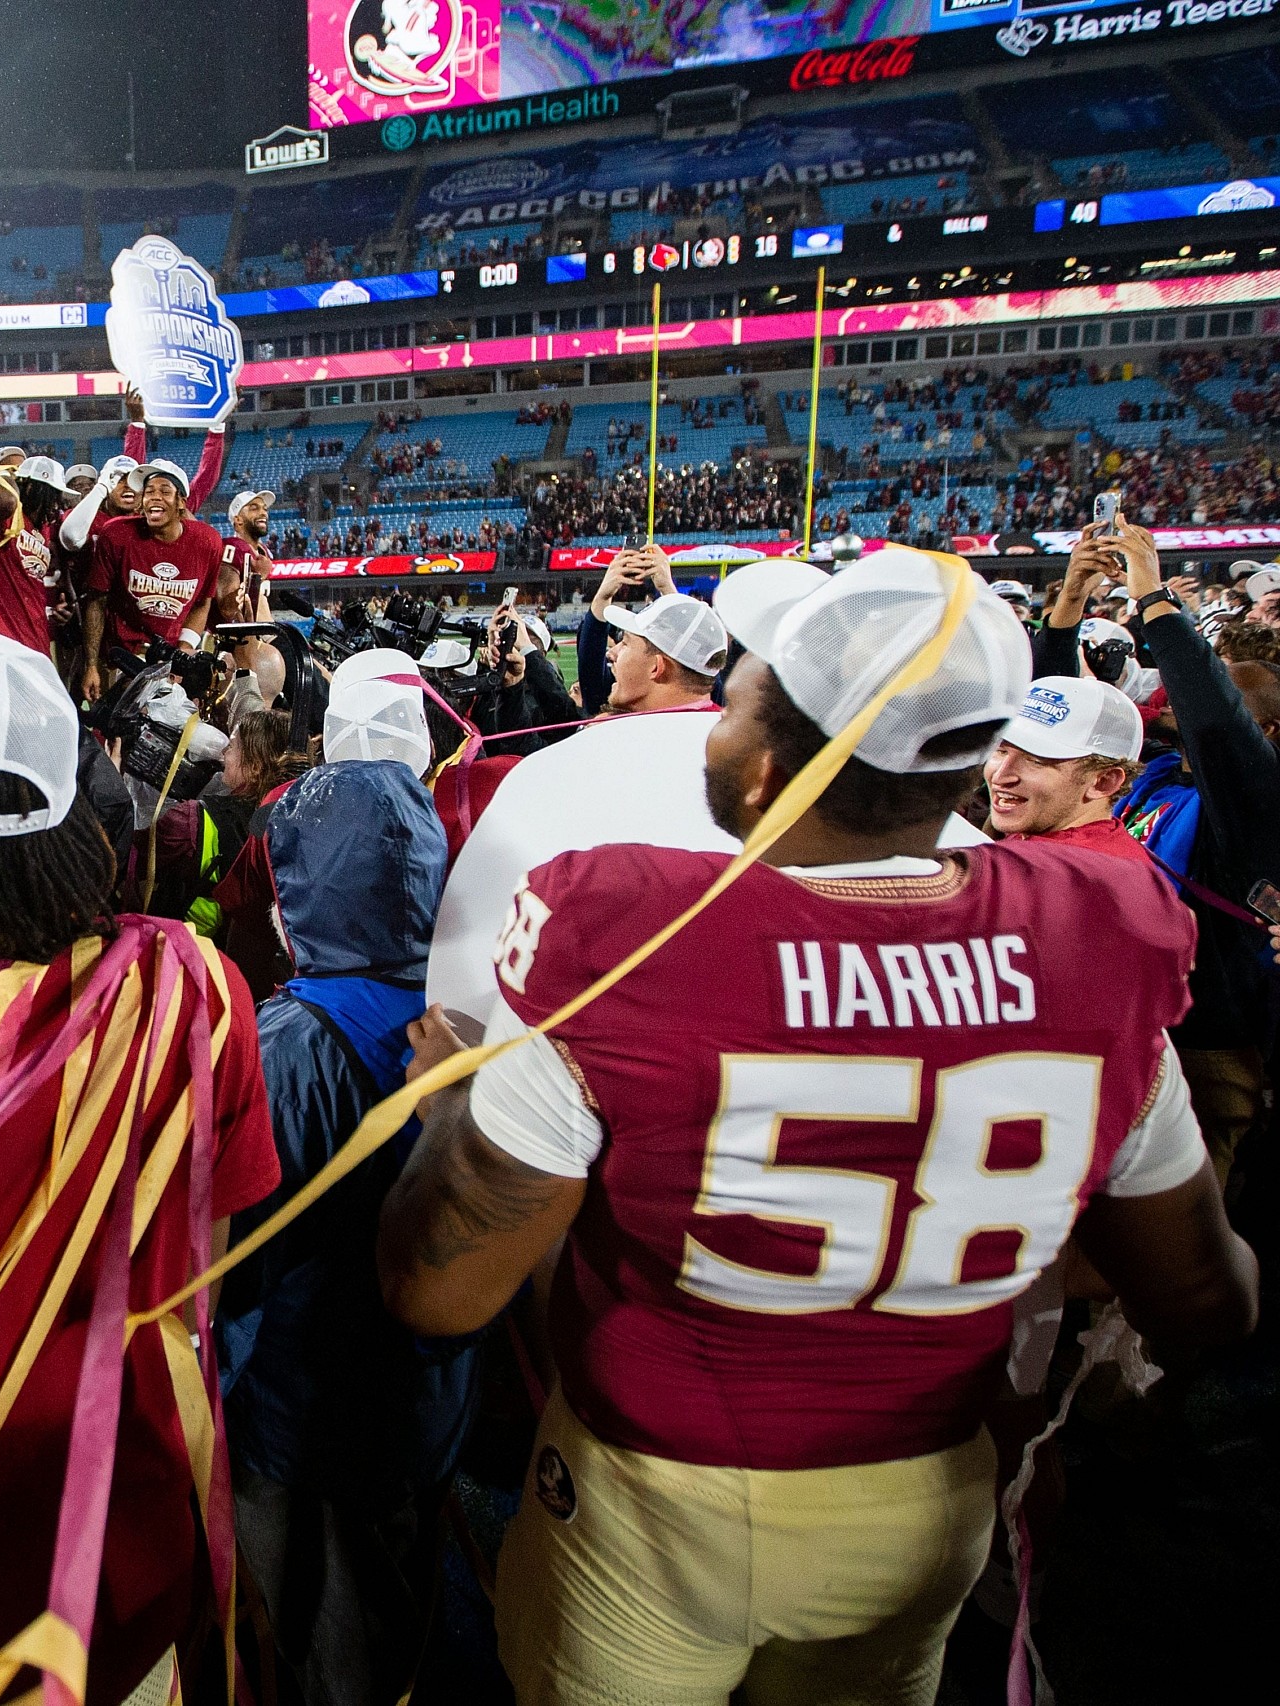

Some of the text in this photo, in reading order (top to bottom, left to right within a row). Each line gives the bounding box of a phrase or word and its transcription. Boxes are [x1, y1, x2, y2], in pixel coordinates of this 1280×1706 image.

[1052, 0, 1278, 44] Harris Teeter
[422, 87, 619, 141] Atrium Health
[254, 138, 320, 167] LOWE'S
[1070, 202, 1098, 223] 40
[147, 251, 171, 261] ACC
[480, 263, 518, 288] 0:00
[138, 311, 234, 368] MPIONSHIP
[161, 385, 196, 400] 2023
[130, 571, 197, 600] CHAMPIONS
[1022, 697, 1068, 720] AMPIONS
[1033, 688, 1060, 701] ACC
[776, 934, 1037, 1029] HARRIS
[674, 1051, 1105, 1316] 58
